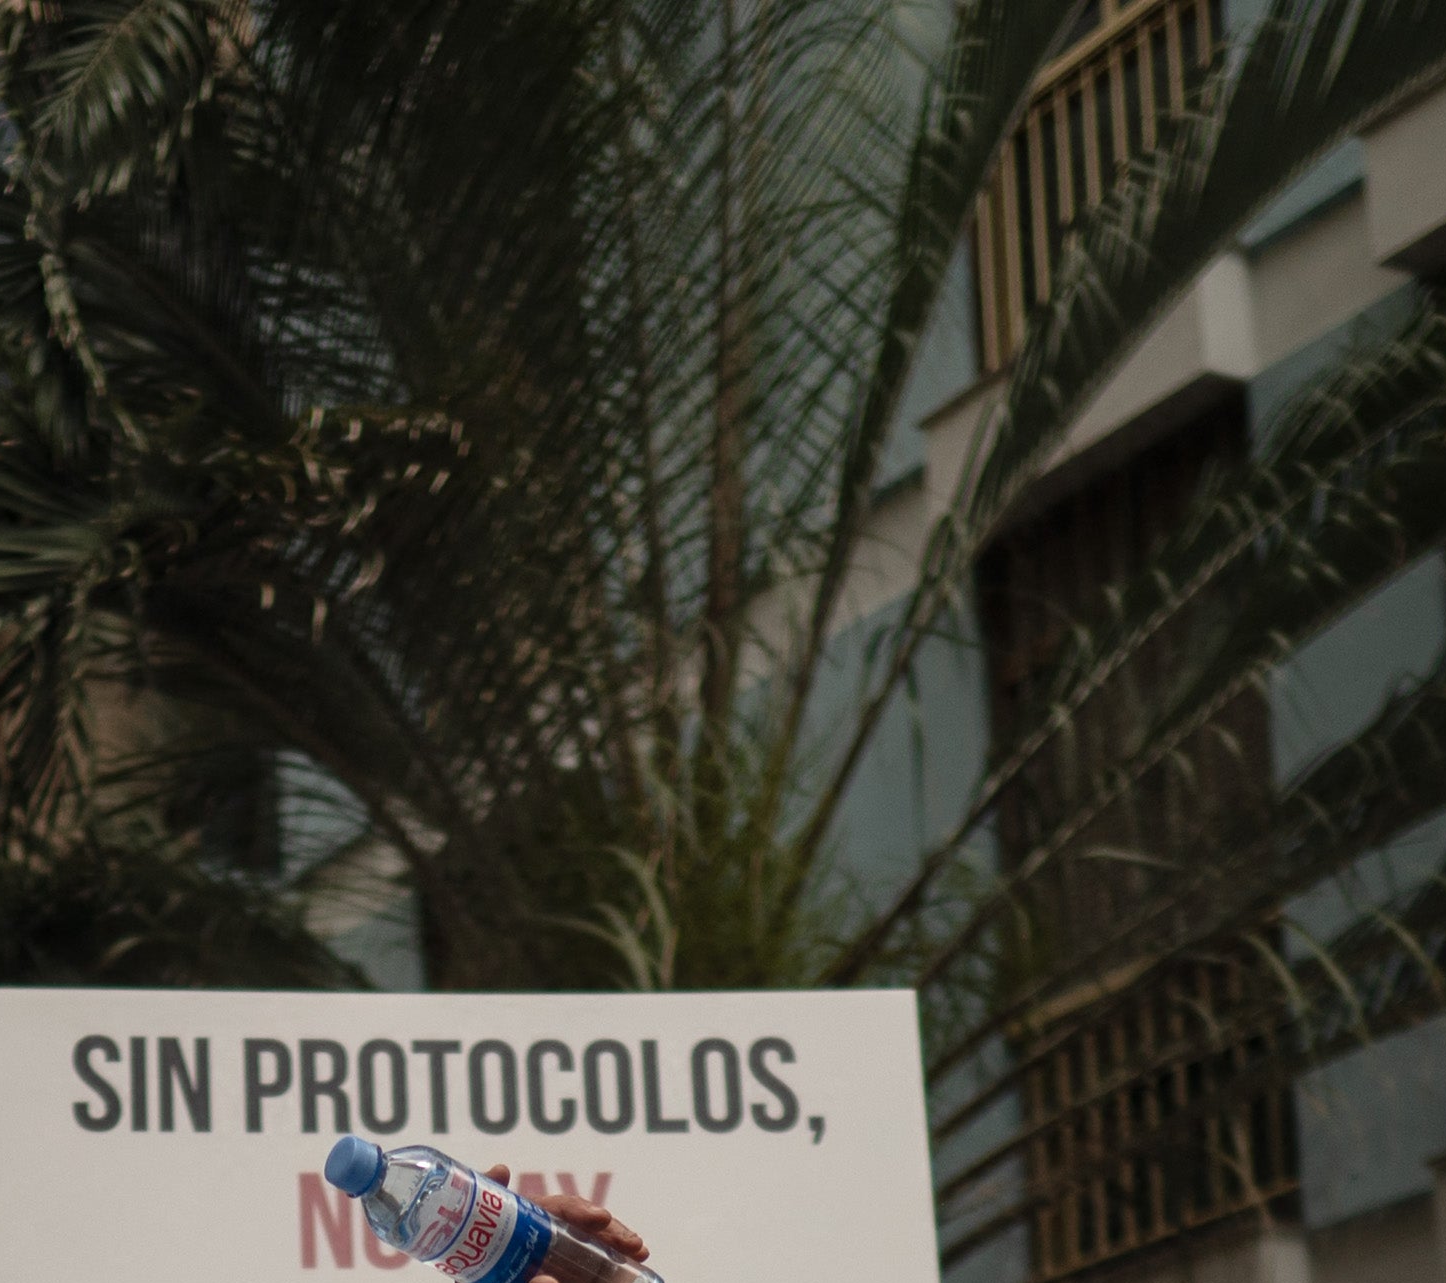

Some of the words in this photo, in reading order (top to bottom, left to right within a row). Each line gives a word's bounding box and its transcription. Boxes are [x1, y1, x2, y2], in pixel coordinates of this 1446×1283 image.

[71, 1034, 211, 1134] SIN
[242, 1036, 827, 1145] PROTOCOLOS,
[434, 1189, 504, 1276] aquavia
